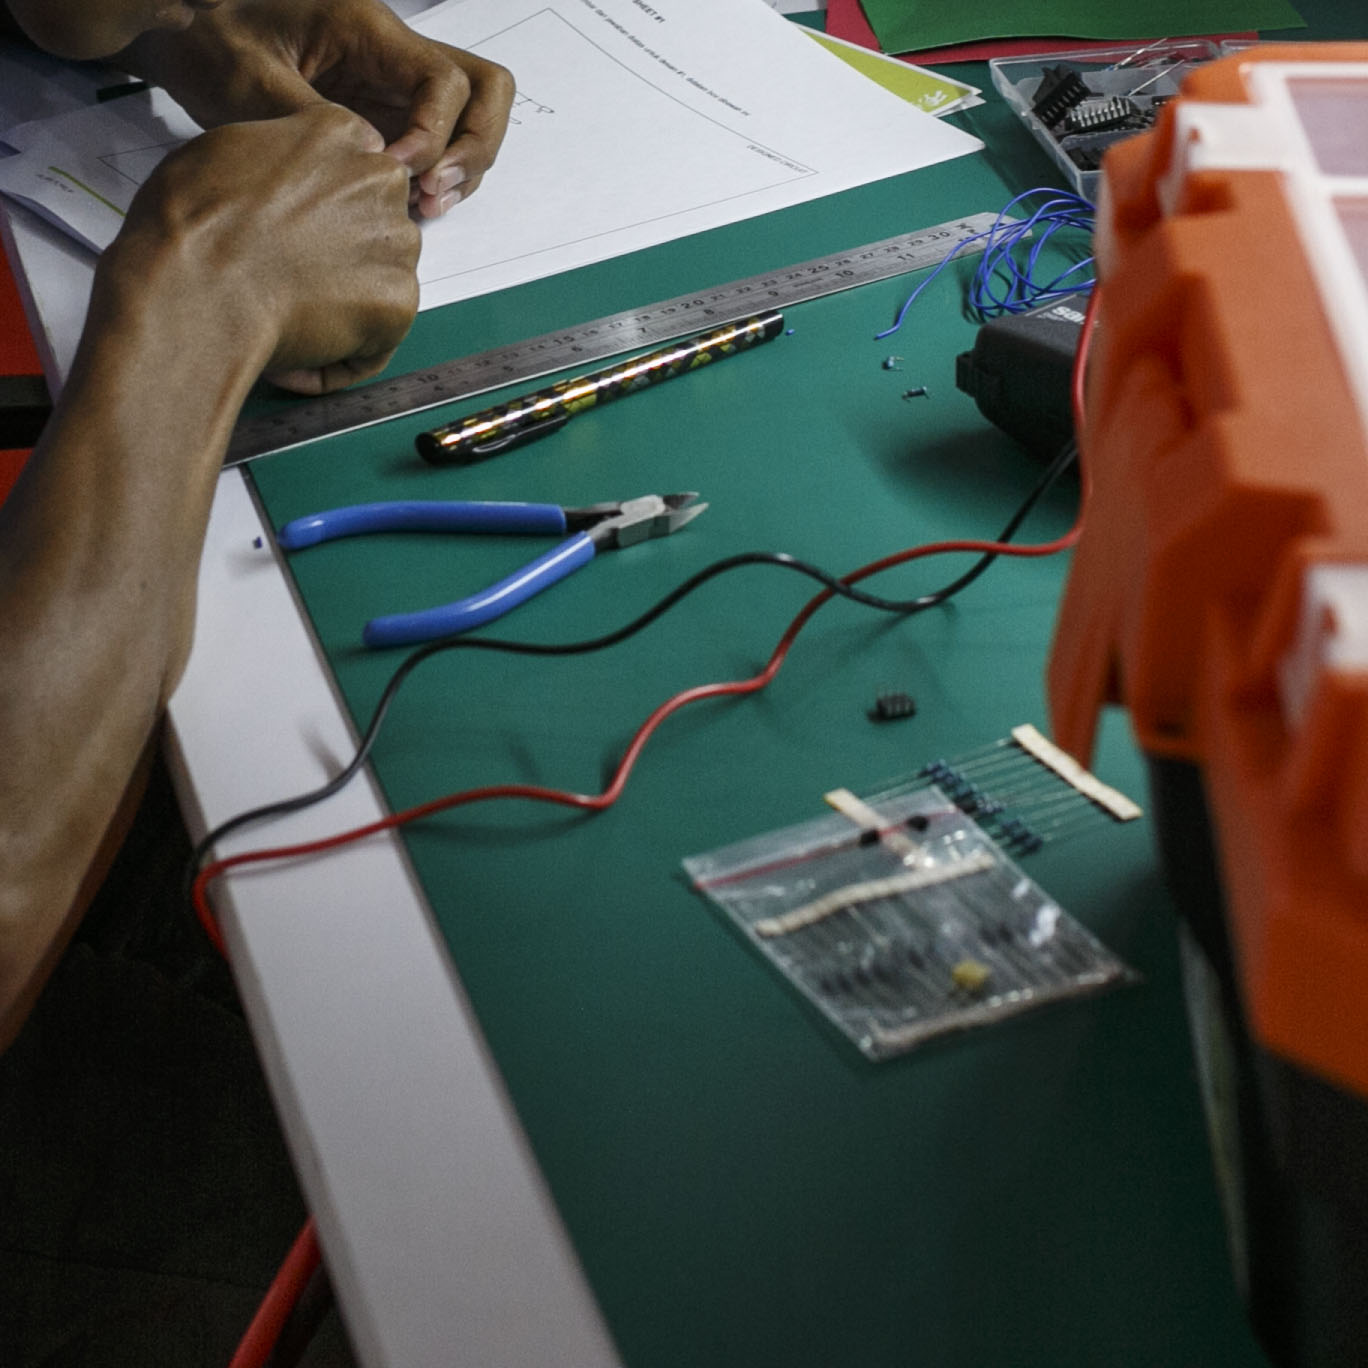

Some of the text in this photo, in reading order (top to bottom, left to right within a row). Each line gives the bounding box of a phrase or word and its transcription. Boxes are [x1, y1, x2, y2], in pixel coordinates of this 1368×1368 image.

[681, 299, 705, 310] 20
[807, 264, 830, 274] 25
[928, 231, 951, 241] 30
[835, 269, 854, 279] 10
[897, 253, 916, 262] 11
